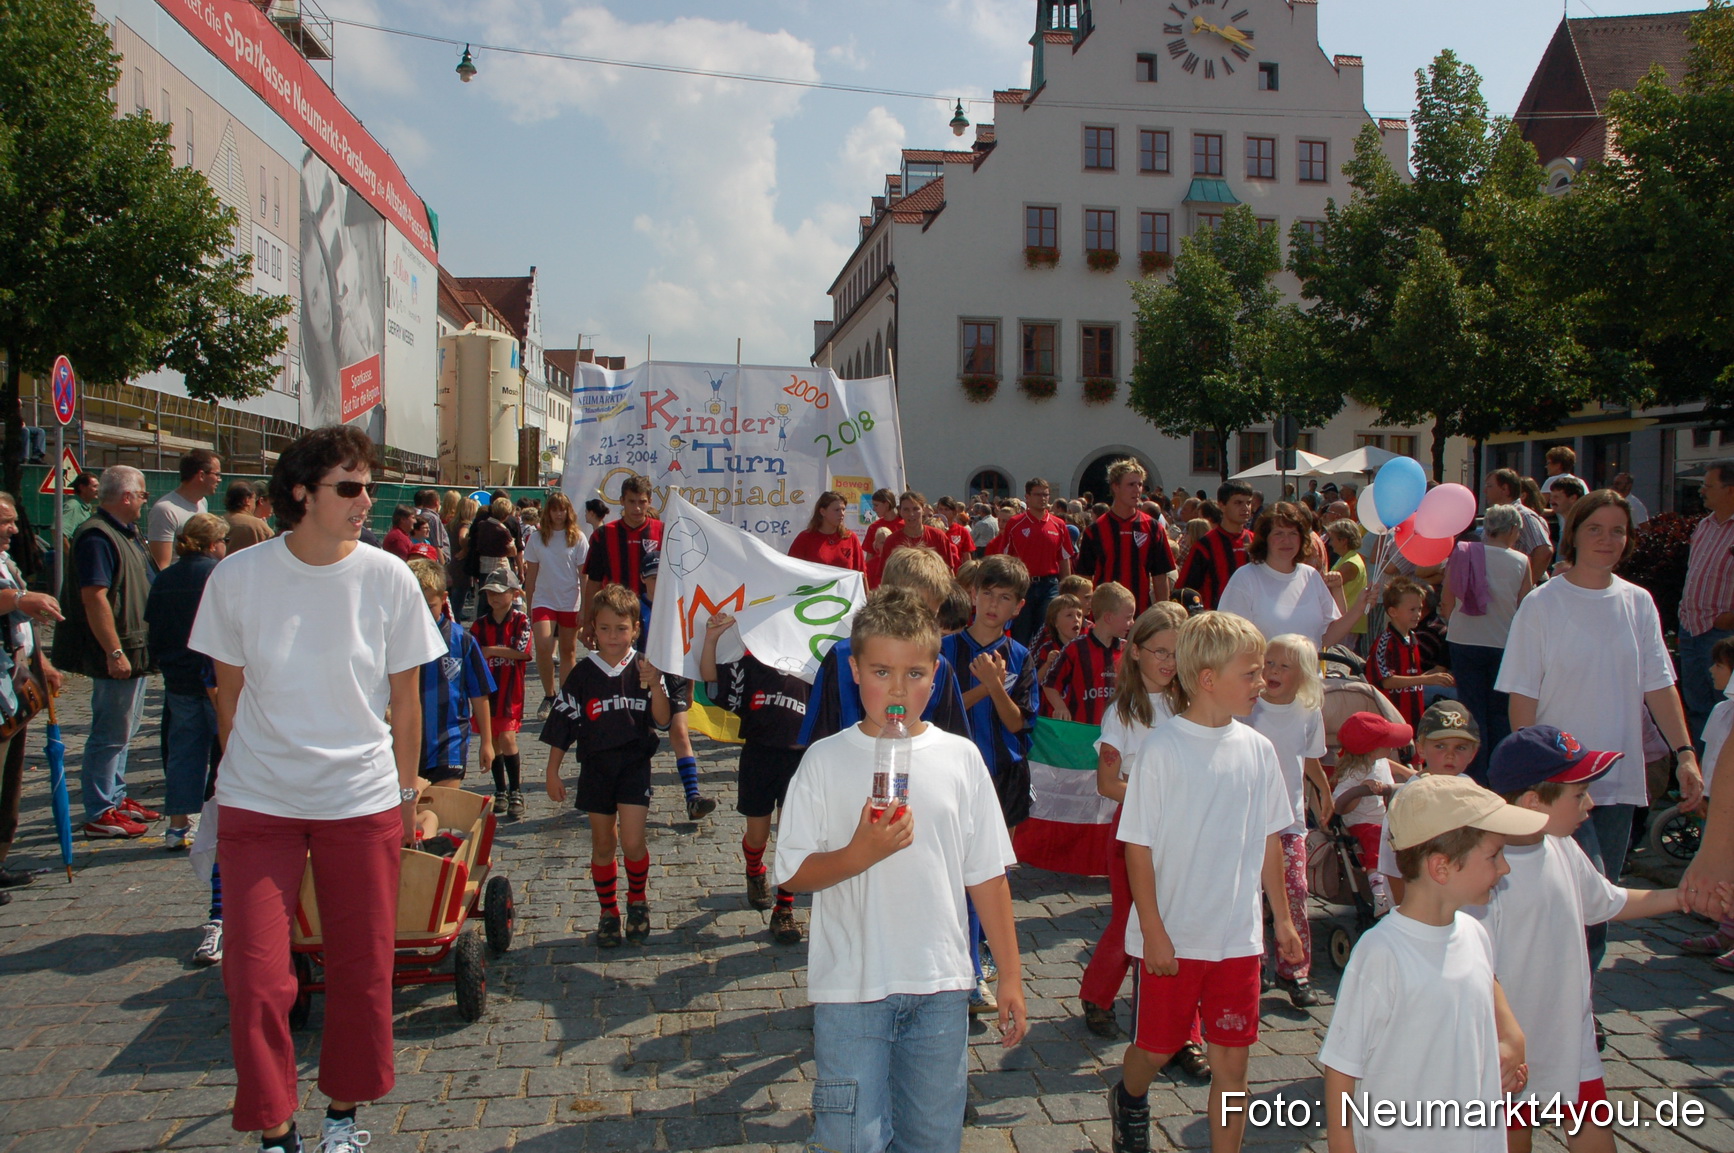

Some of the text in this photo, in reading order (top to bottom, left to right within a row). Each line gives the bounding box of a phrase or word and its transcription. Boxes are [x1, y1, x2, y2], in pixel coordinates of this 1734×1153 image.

[205, 2, 222, 37] die
[223, 11, 291, 105] Sparkasse
[293, 80, 377, 196] Neumarkt-Parsberg
[343, 399, 353, 415] Gut
[352, 394, 360, 411] für
[782, 374, 830, 410] 2000
[640, 387, 776, 435] Kinder
[588, 449, 658, 466] Mai 2004
[691, 437, 788, 475] Turn
[598, 466, 805, 514] Oympiade
[587, 694, 647, 721] erima
[750, 690, 807, 715] erima
